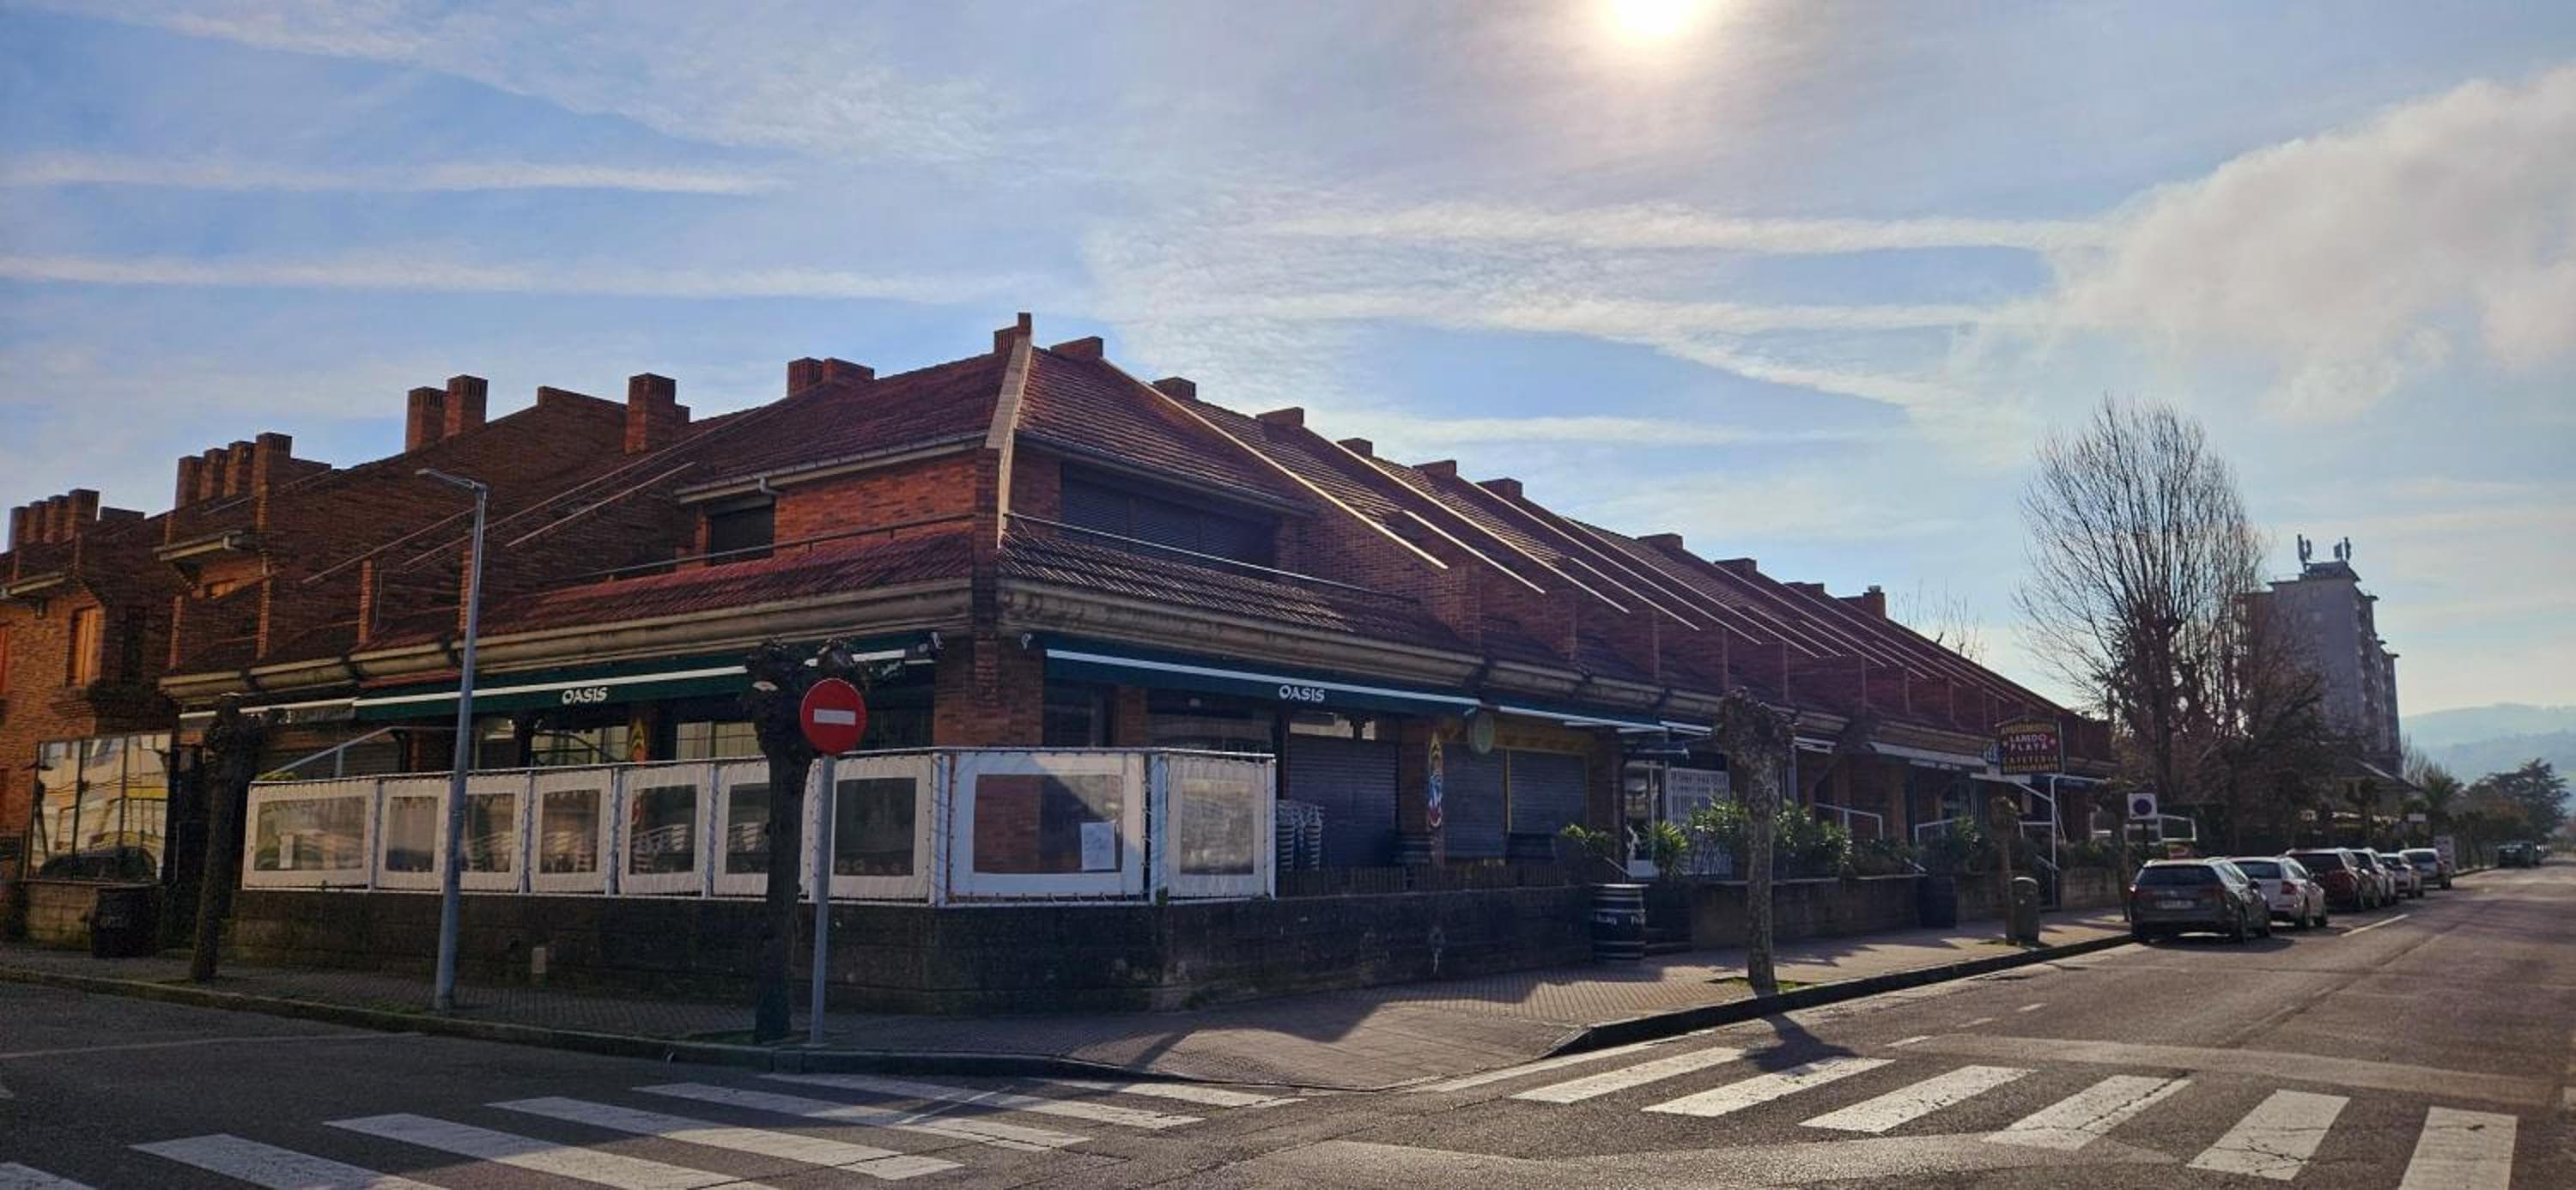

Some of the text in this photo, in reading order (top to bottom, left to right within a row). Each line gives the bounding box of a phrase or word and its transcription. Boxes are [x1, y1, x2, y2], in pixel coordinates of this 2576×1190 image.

[562, 686, 608, 705] OASIS
[1279, 685, 1325, 702] OASIS
[2010, 743, 2048, 751] PLAYA
